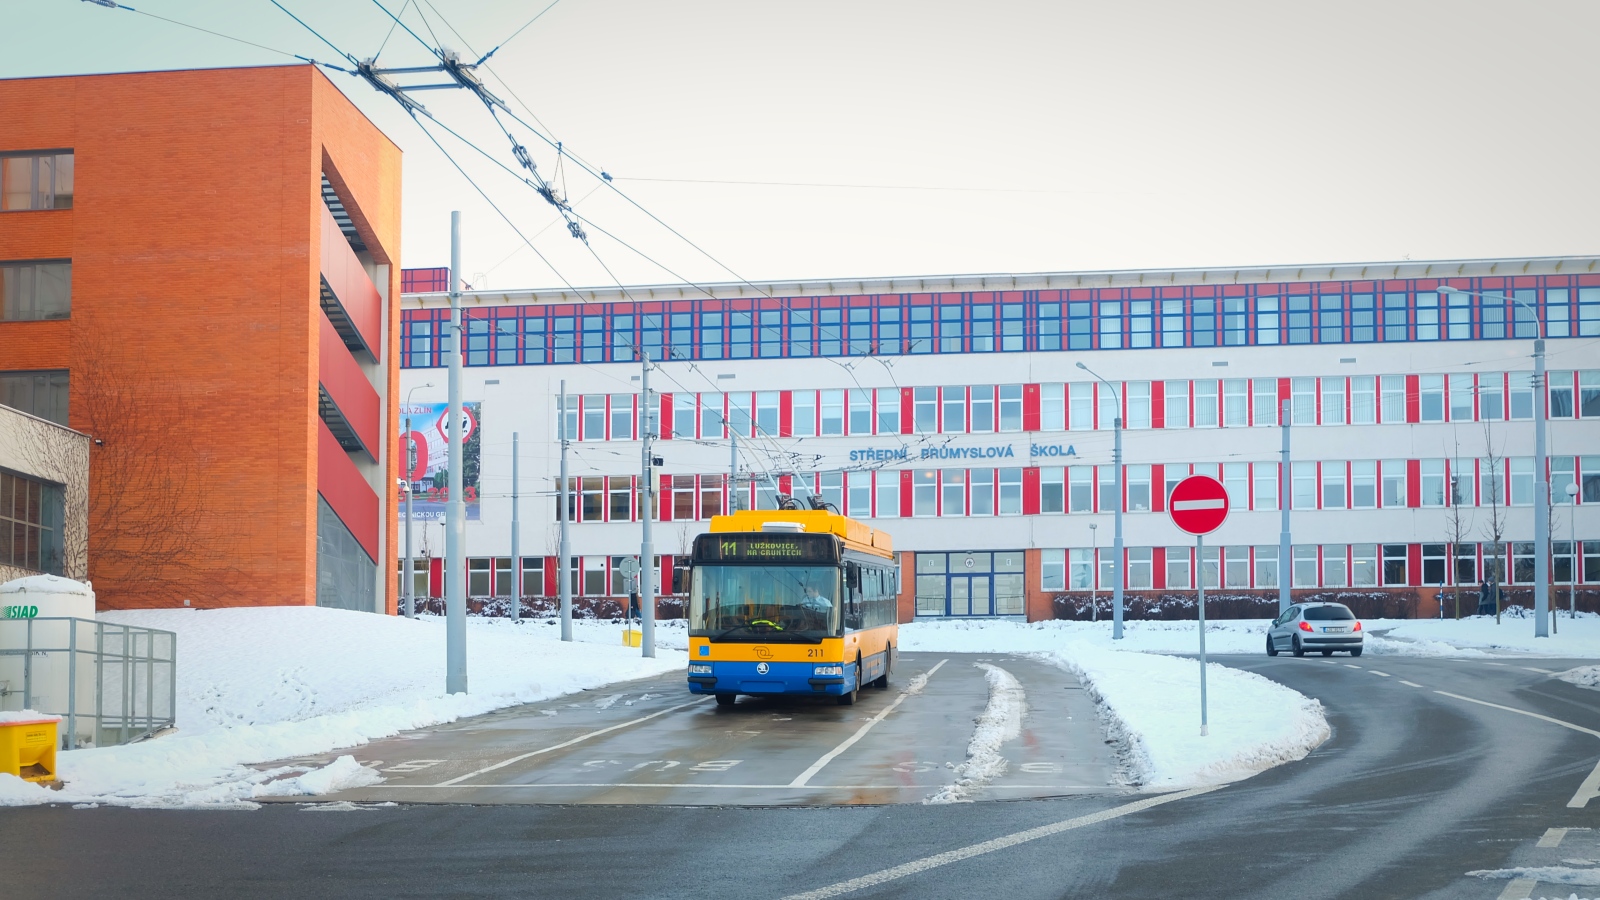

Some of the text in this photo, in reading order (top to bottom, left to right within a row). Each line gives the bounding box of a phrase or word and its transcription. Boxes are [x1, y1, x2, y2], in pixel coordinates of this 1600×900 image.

[414, 406, 432, 414] ZLÍN
[849, 443, 1076, 461] STŘEDNÍ PRŮMYSLOVÁ ŠKOLA
[427, 486, 477, 503] 203
[398, 511, 435, 519] ECNICKOU
[721, 541, 737, 556] 11
[11, 605, 39, 618] SIAD
[807, 649, 824, 658] 211
[892, 761, 1065, 774] BS
